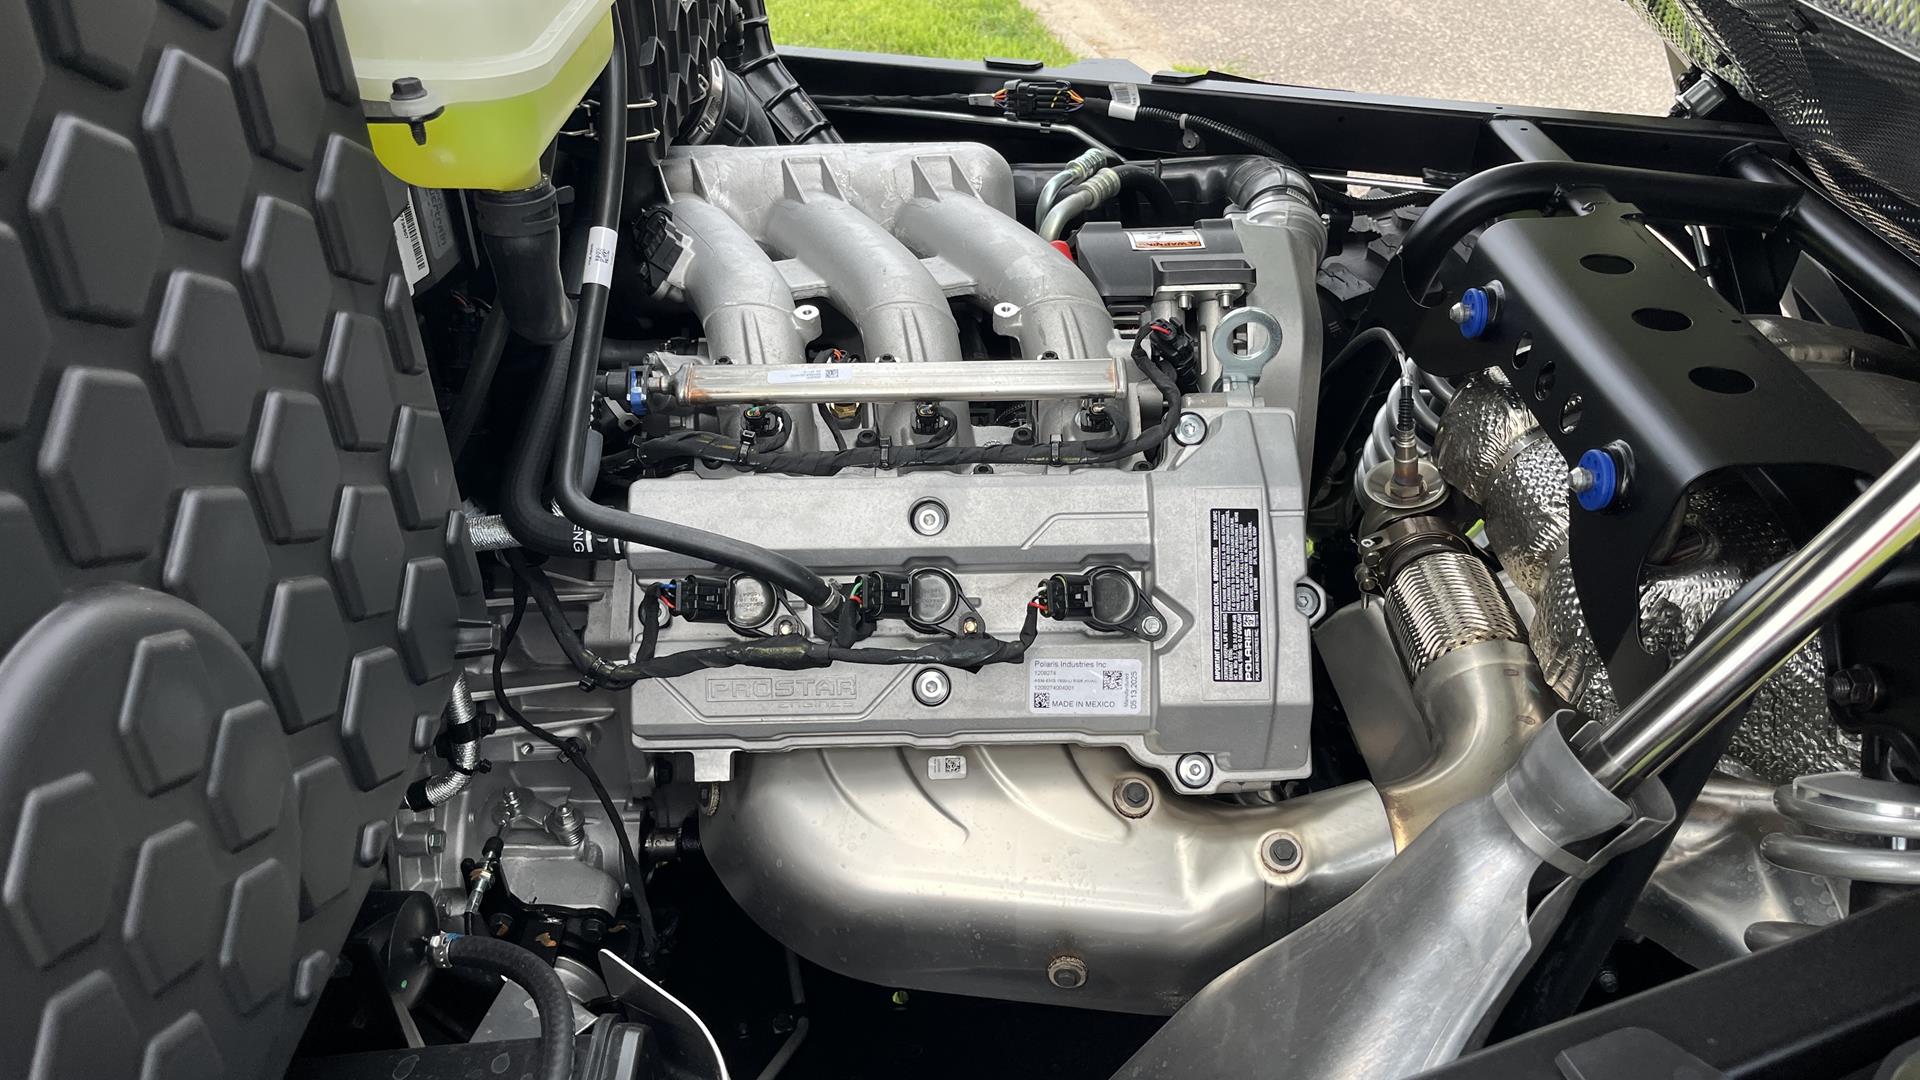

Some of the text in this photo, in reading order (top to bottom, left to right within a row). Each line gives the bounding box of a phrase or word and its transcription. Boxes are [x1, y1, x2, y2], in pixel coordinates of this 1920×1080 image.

[1244, 628, 1252, 680] POLARIS
[1034, 660, 1058, 668] Polaris
[1061, 660, 1094, 668] Industries
[710, 679, 857, 698] PROSTAR
[1052, 700, 1115, 708] MADE IN MEXICO
